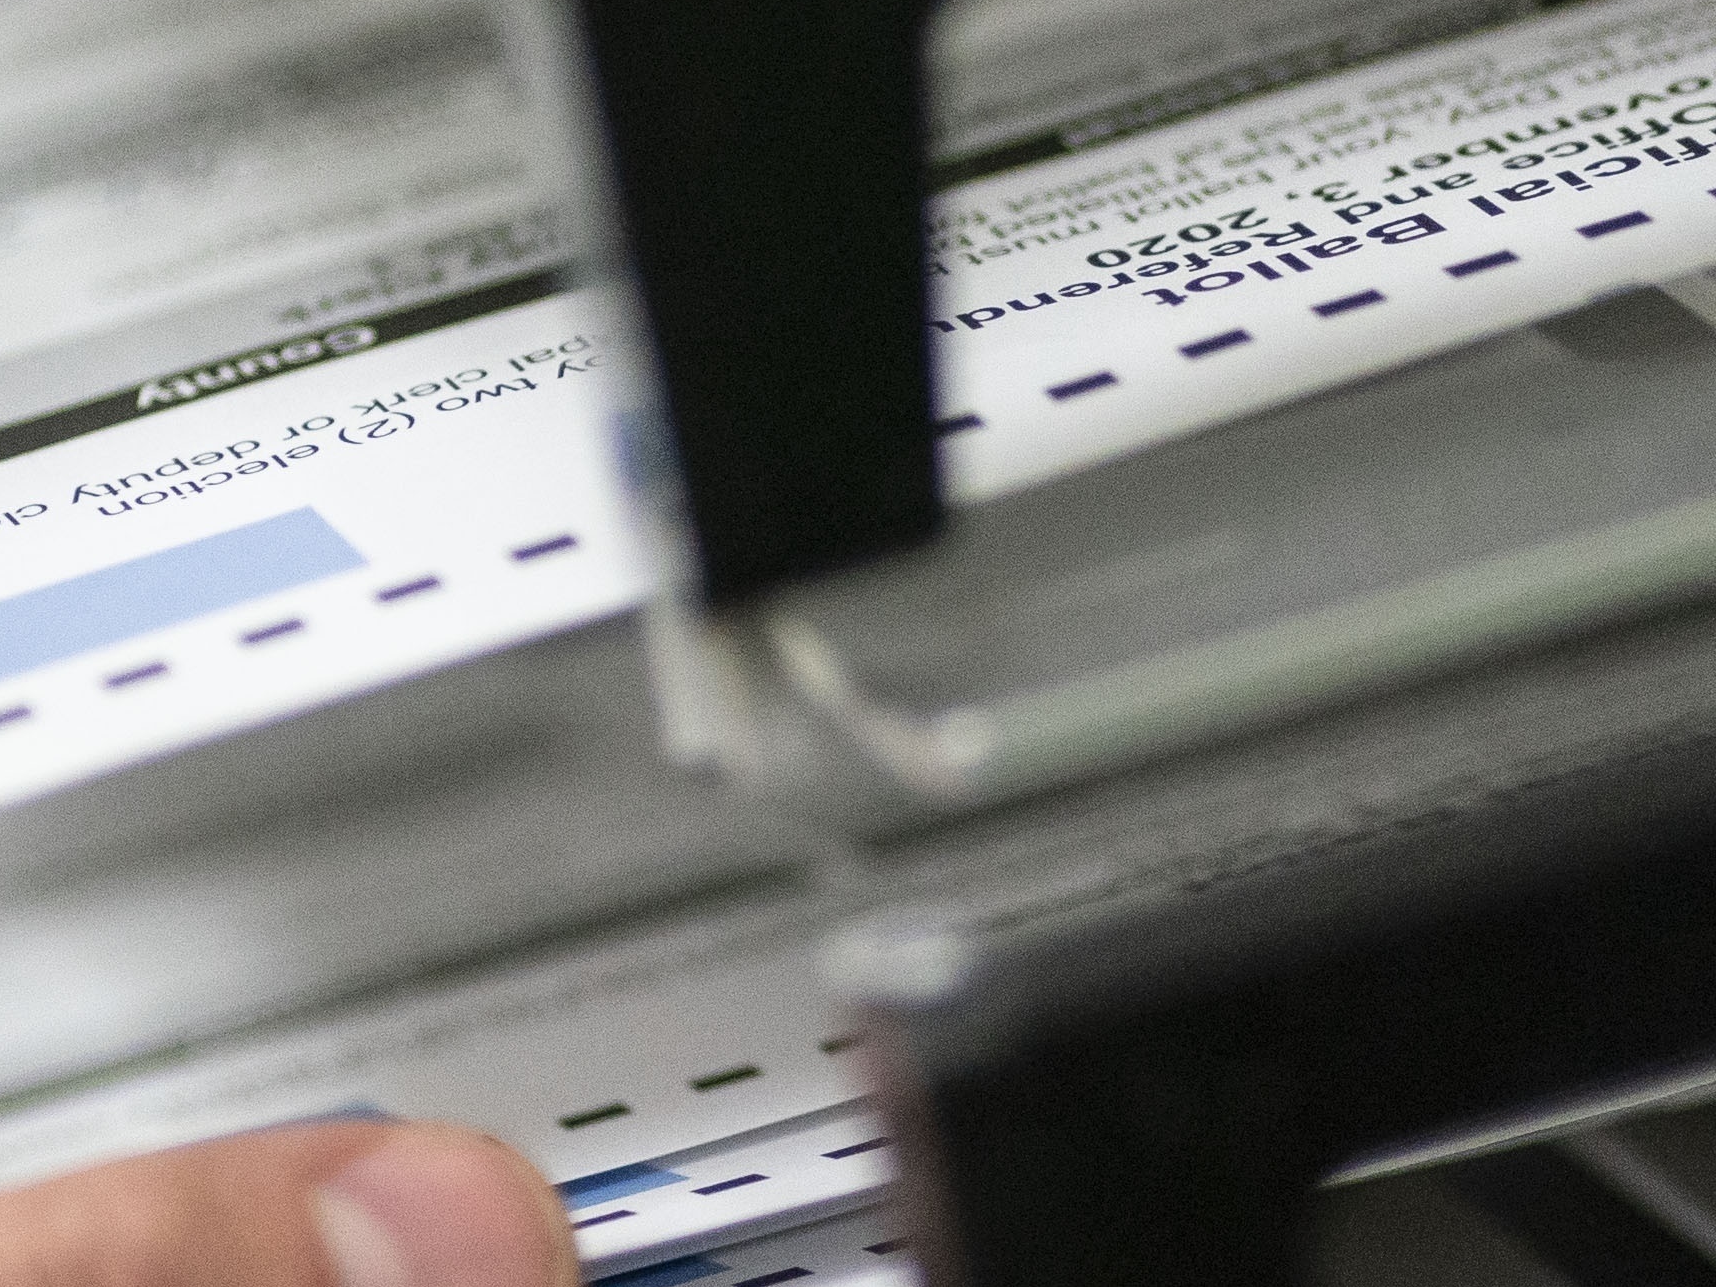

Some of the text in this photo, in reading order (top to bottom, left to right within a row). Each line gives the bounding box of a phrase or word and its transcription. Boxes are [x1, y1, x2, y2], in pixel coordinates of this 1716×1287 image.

[1284, 180, 1360, 206] 3,
[1333, 170, 1476, 227] and
[1084, 206, 1269, 271] 2020
[1143, 211, 1447, 308] Ballot
[130, 326, 380, 413] County
[354, 366, 491, 417] clerk
[433, 375, 539, 414] two
[285, 413, 338, 441] or
[335, 410, 418, 447] (2)
[69, 438, 263, 506] deputy
[95, 441, 322, 519] election
